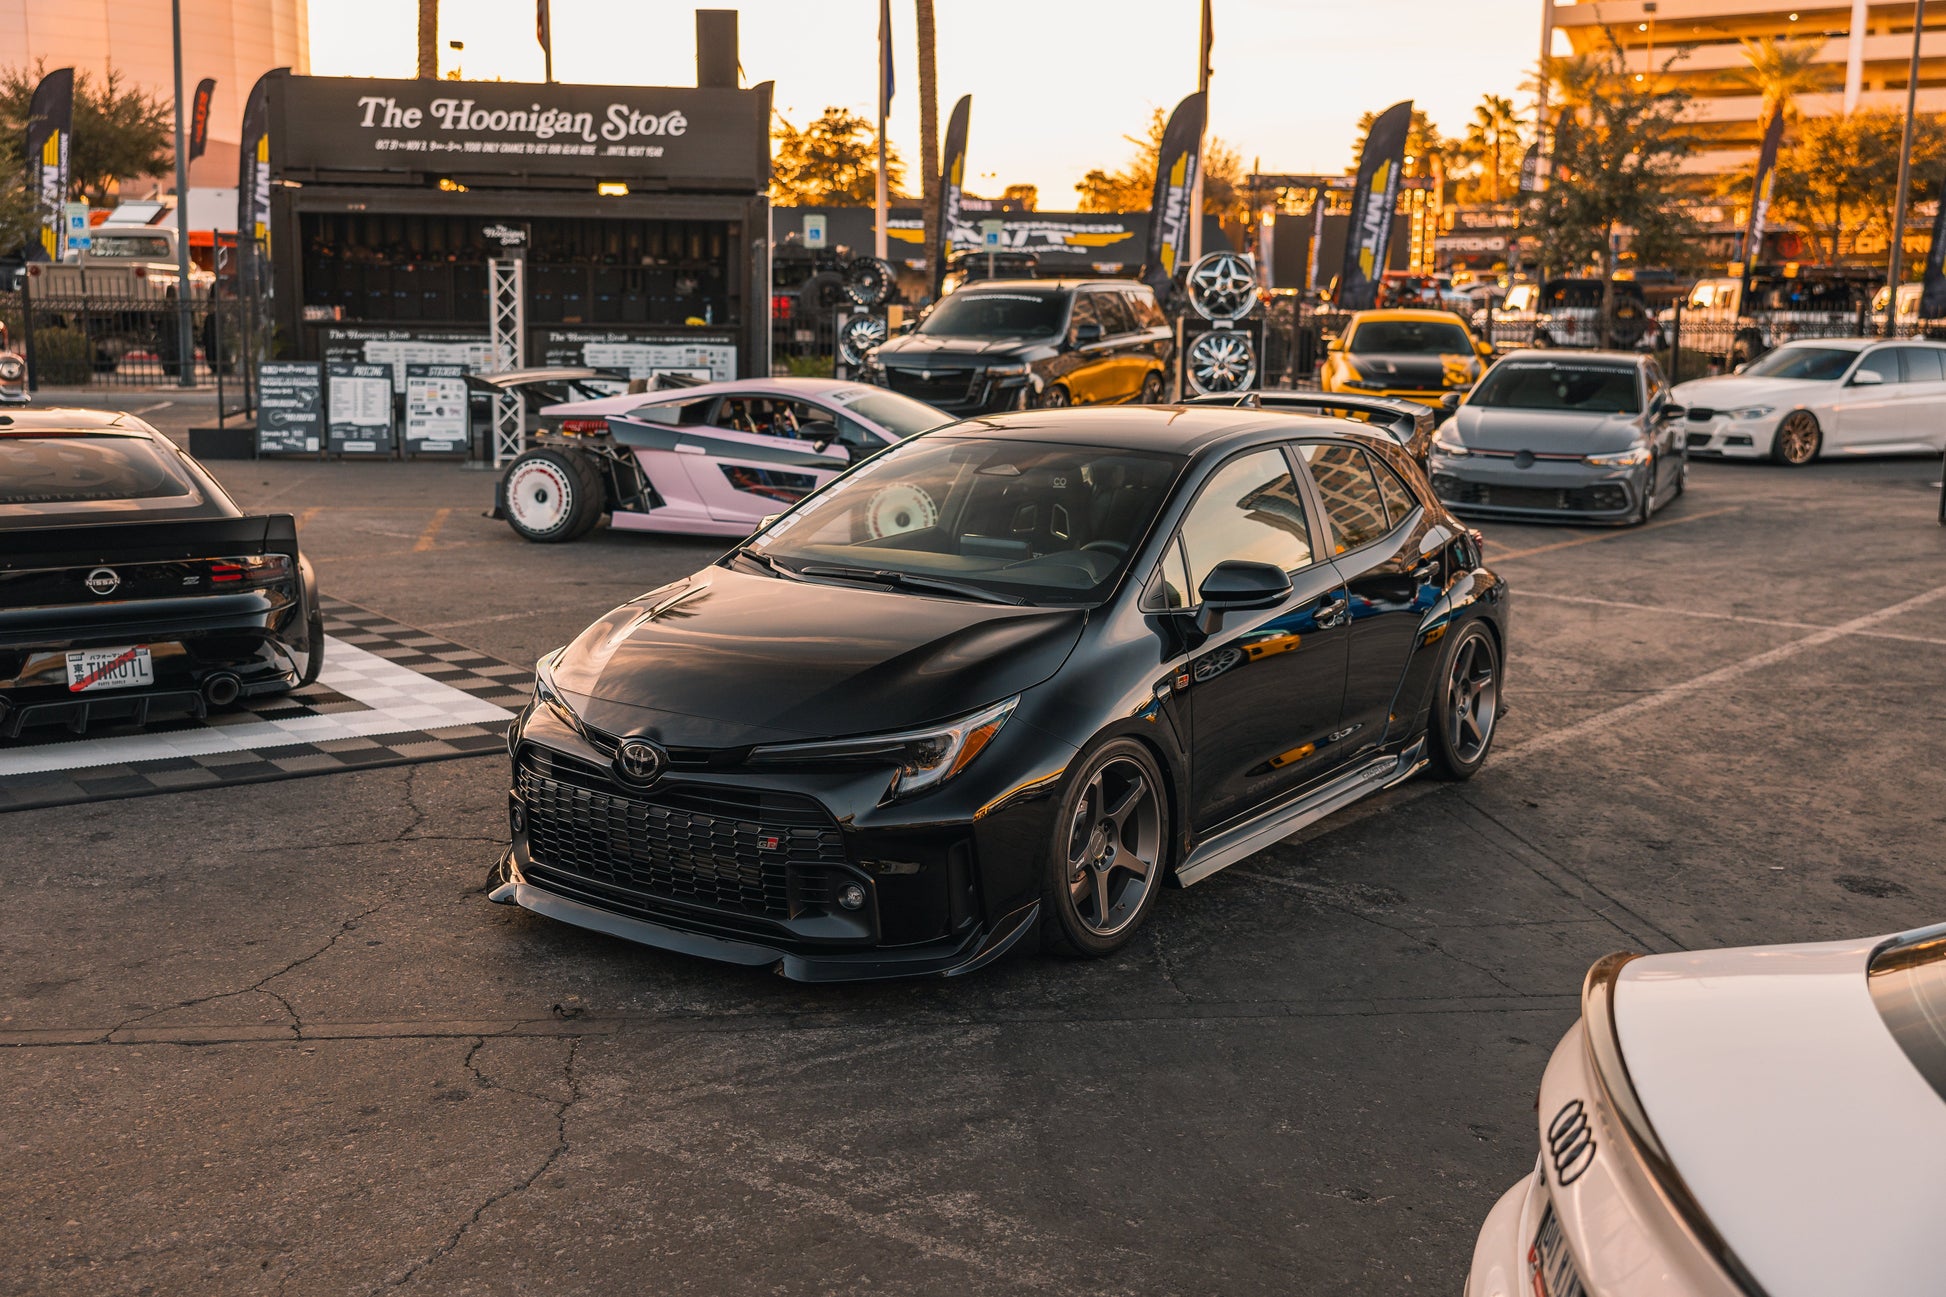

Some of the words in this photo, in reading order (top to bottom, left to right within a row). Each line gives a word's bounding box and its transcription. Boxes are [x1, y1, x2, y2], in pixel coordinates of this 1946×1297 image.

[358, 96, 423, 129] The
[430, 98, 598, 143] Hoonigan
[601, 103, 688, 141] Store
[352, 365, 385, 377] PRICING
[85, 577, 121, 586] NISSAN
[86, 657, 149, 682] THROTL
